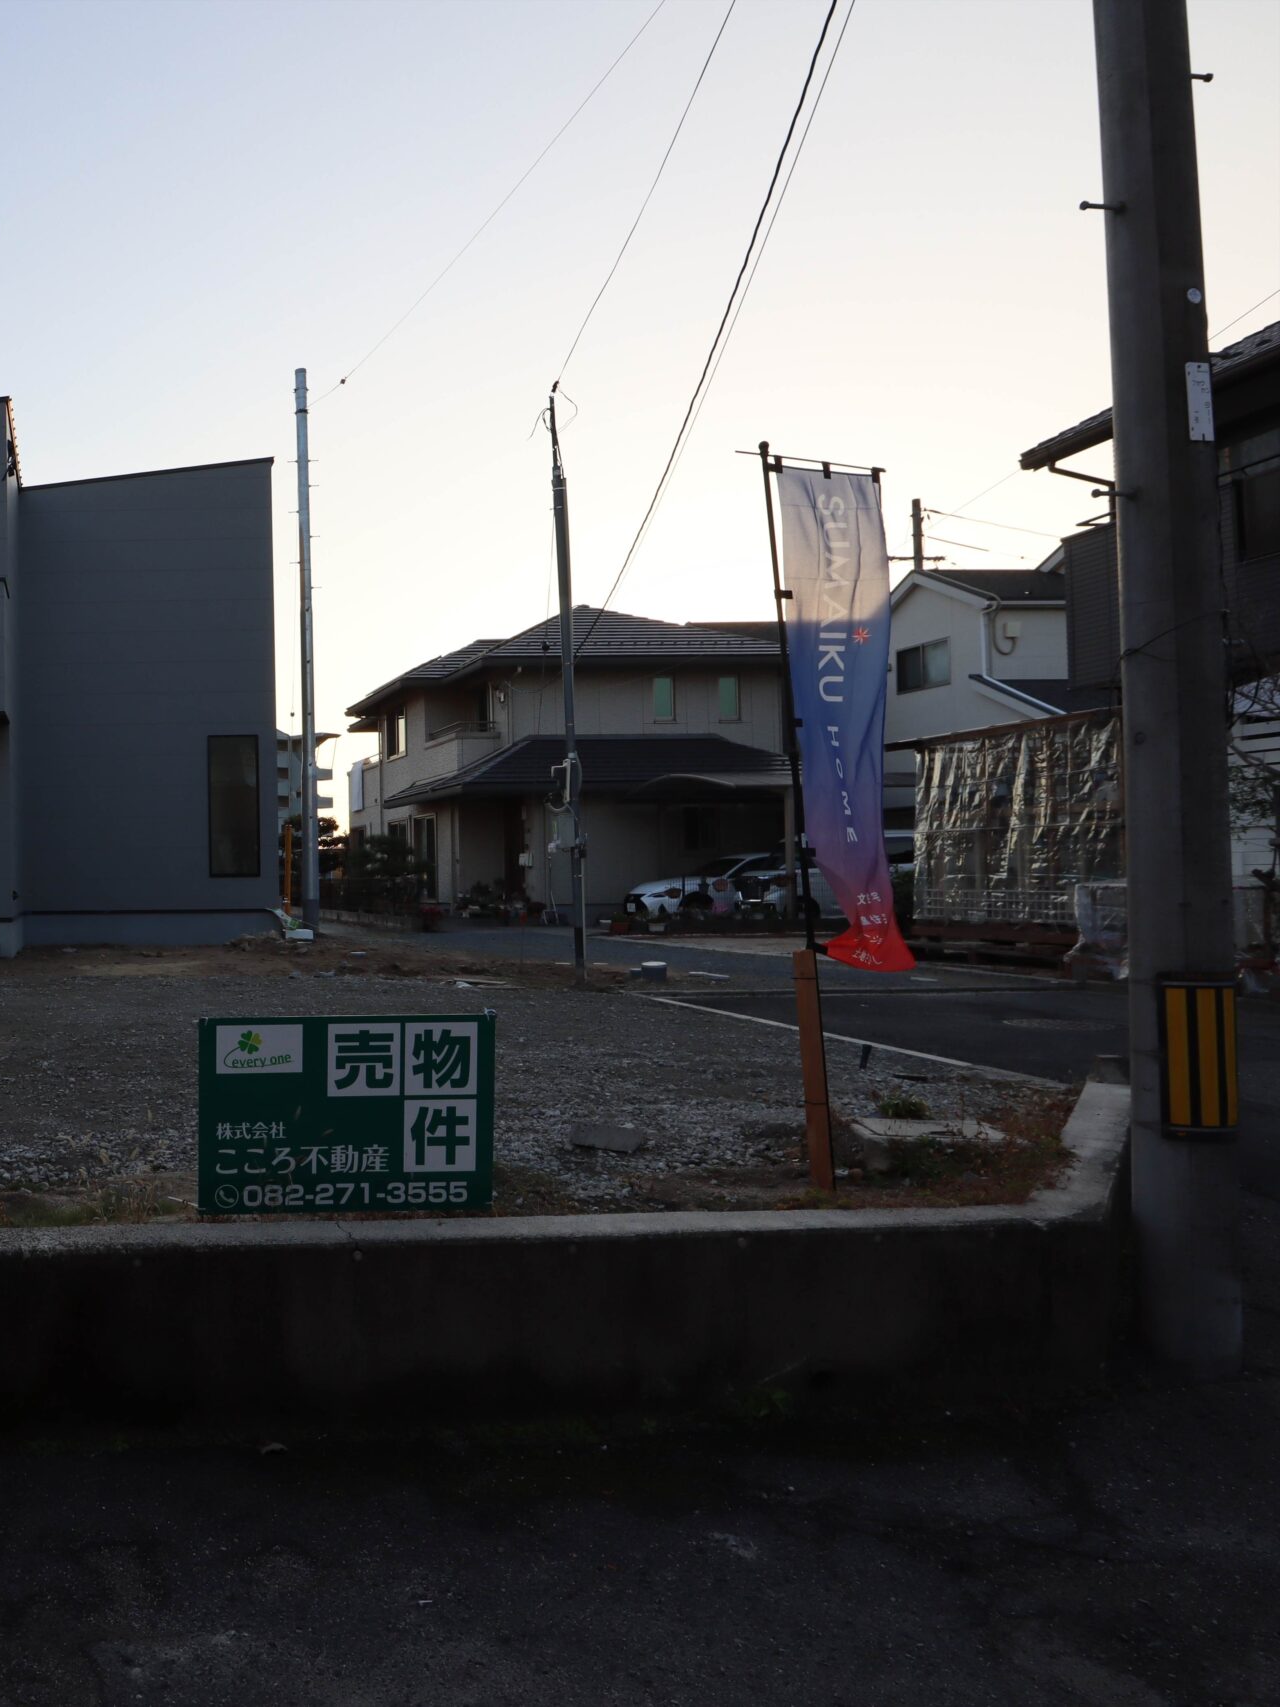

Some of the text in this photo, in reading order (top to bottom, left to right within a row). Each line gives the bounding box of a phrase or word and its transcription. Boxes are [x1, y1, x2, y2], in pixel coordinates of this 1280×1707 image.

[818, 493, 858, 844] SUMAIKU HOME
[231, 1053, 292, 1069] every one
[215, 1121, 287, 1140] 株式会社
[215, 1144, 391, 1175] こころ不動産
[243, 1181, 469, 1207] 082-271-3555
